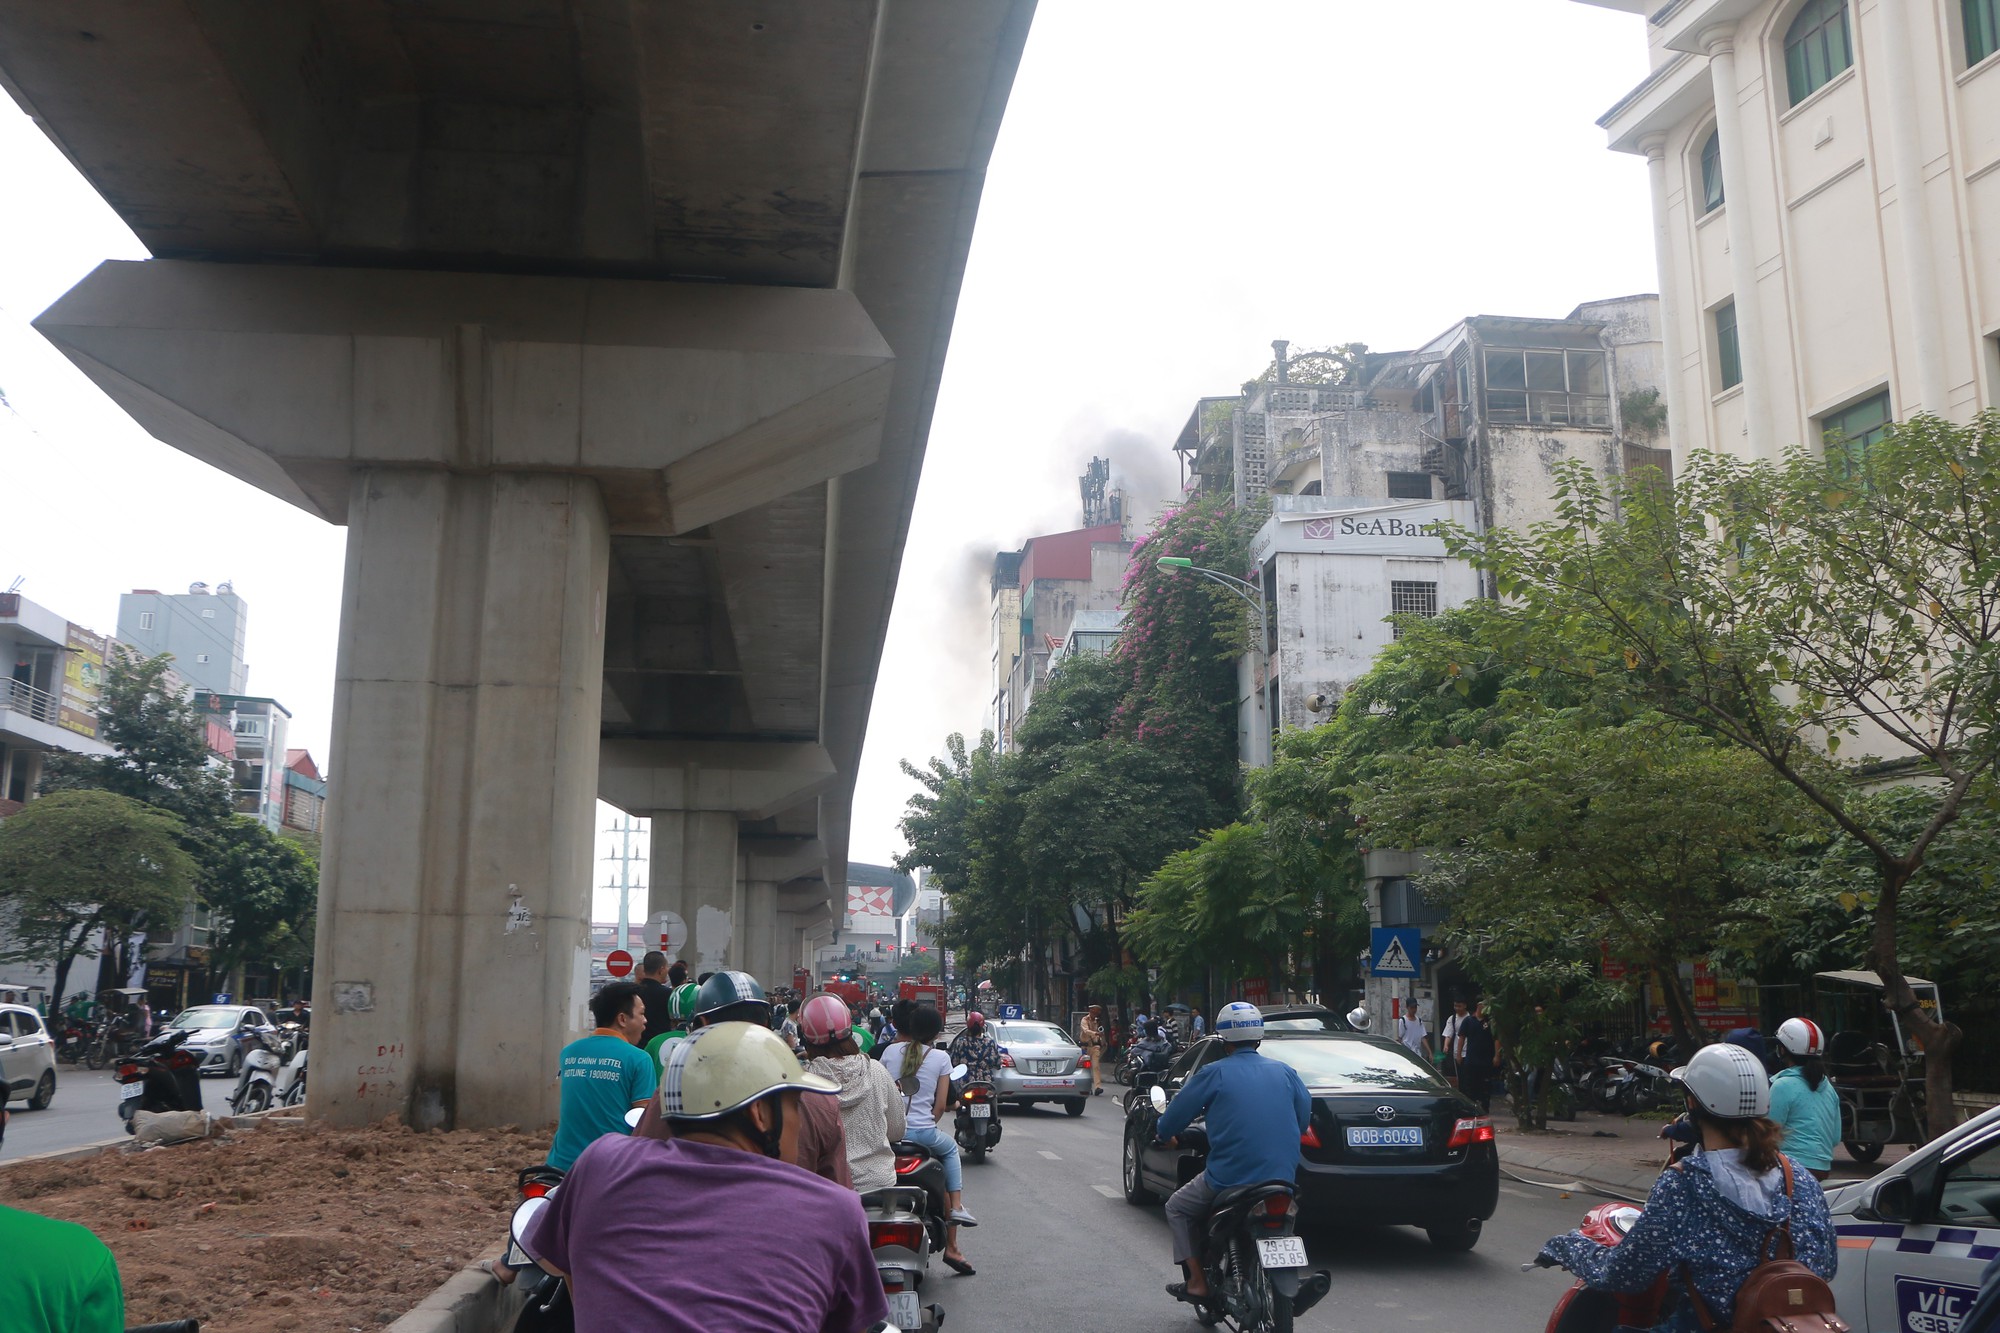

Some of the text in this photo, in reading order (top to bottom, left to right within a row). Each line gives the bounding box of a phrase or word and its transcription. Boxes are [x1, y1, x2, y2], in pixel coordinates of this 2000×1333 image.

[1006, 1006, 1018, 1018] G7
[598, 1058, 622, 1069] VIETTEL
[589, 1069, 620, 1082] 19008095
[1352, 1129, 1418, 1144] 80B-6049
[1263, 1239, 1298, 1253] 29-E2
[1263, 1252, 1304, 1266] 255.85
[886, 1294, 911, 1311] -K7
